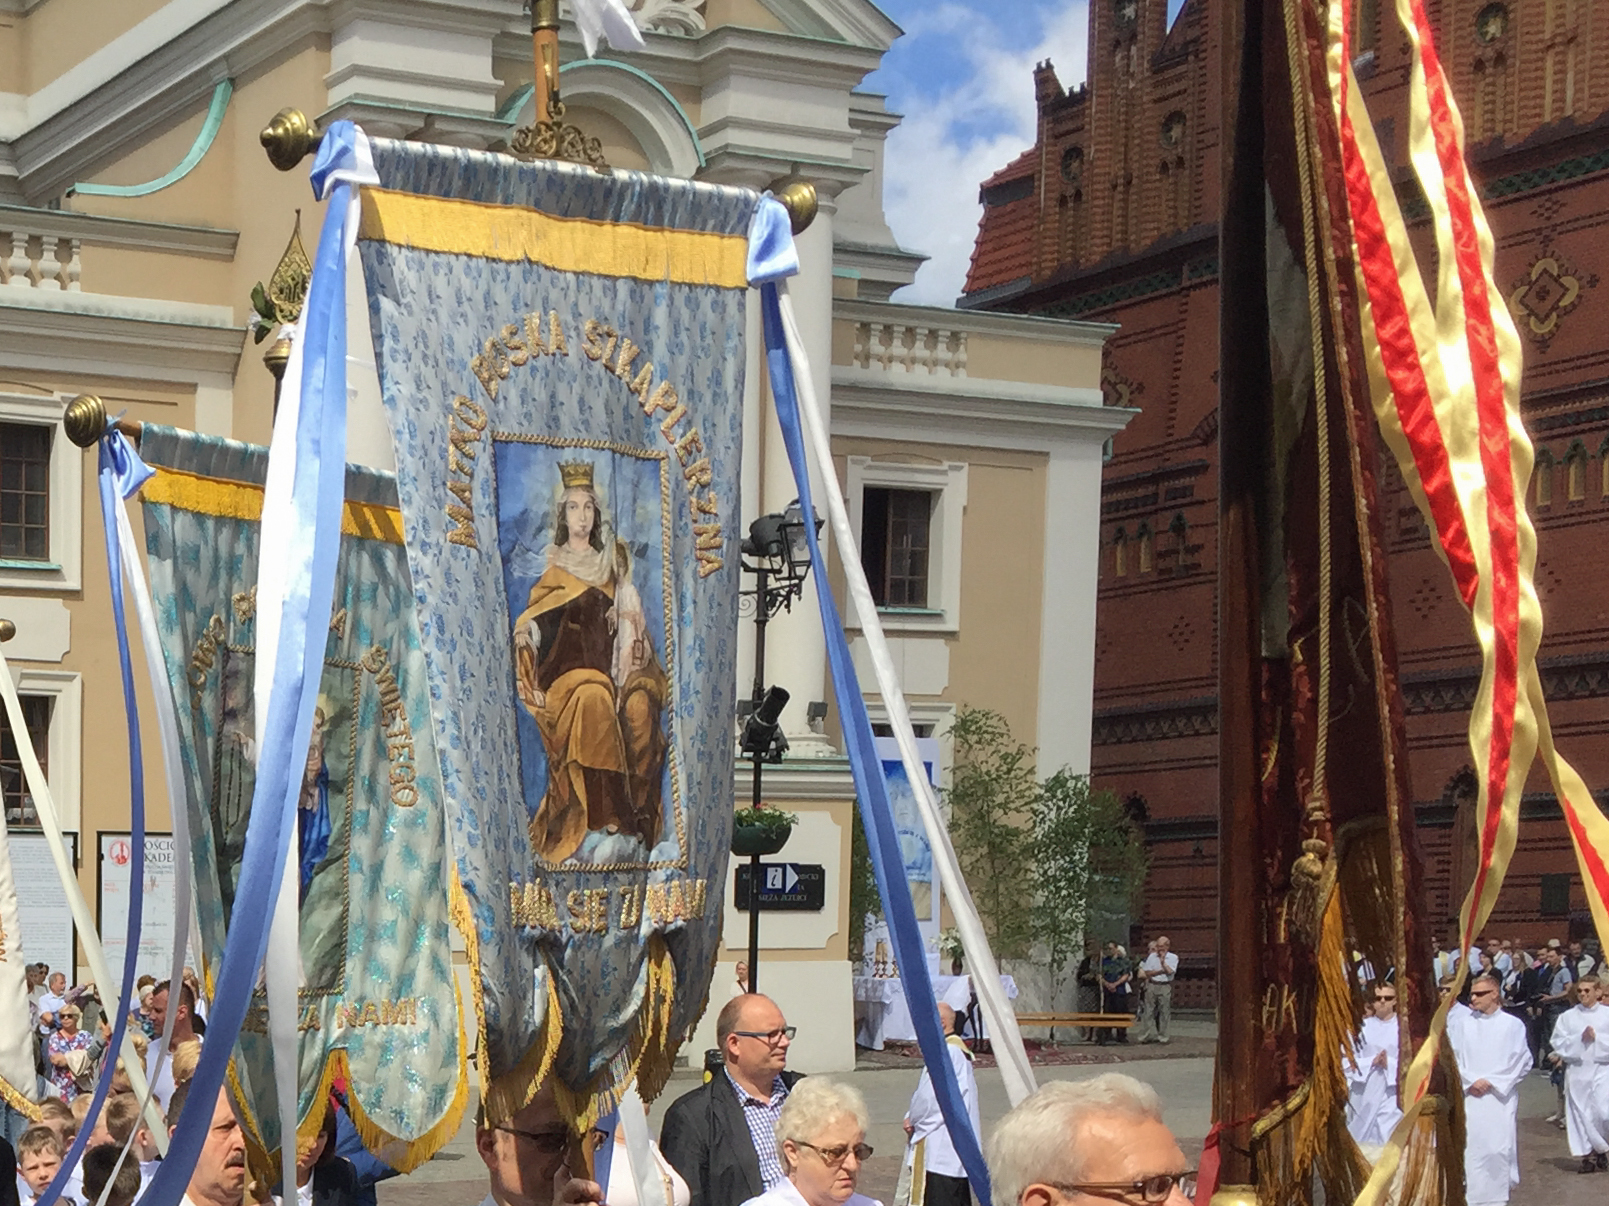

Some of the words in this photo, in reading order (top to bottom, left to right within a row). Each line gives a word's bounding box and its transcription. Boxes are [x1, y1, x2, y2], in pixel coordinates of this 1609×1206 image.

[444, 395, 487, 550] MATKO
[471, 310, 569, 401] BOSKA
[582, 319, 724, 579] SZKAPLERZNA
[335, 998, 418, 1030] NAMI
